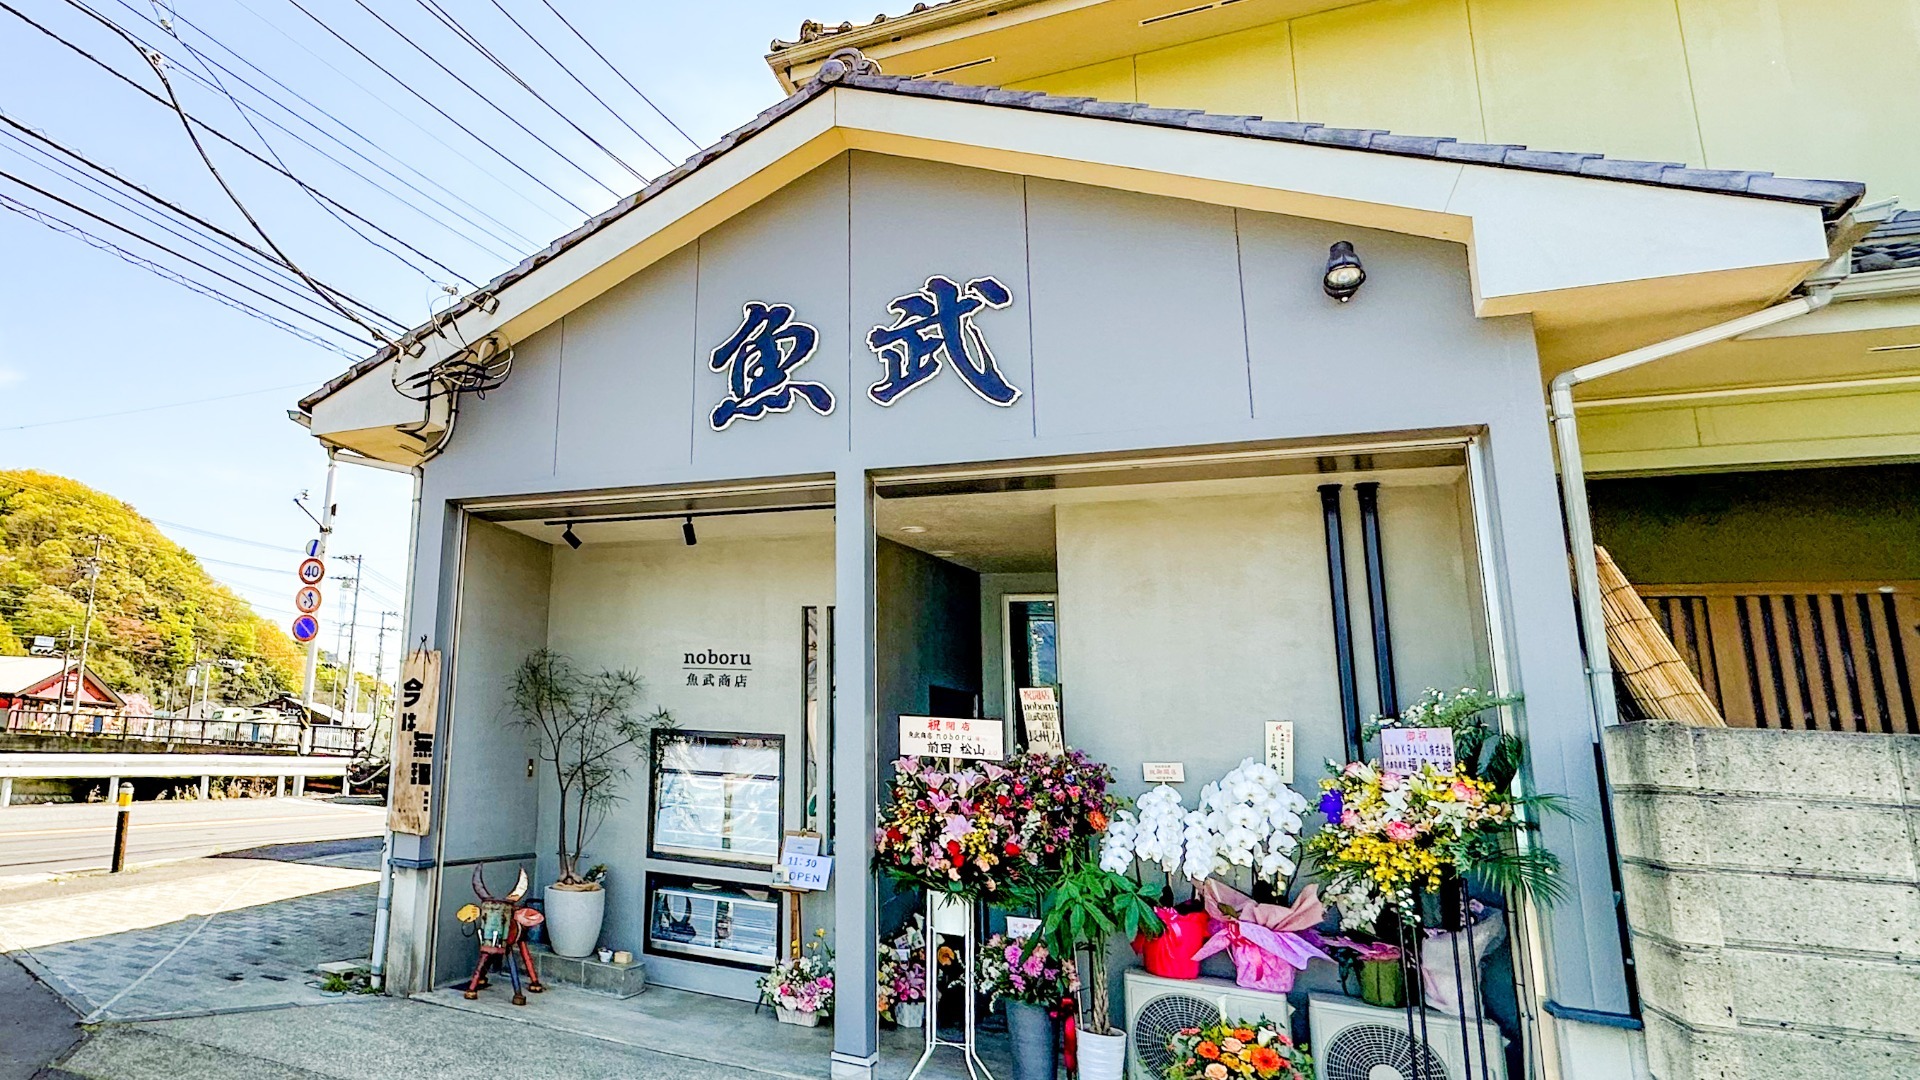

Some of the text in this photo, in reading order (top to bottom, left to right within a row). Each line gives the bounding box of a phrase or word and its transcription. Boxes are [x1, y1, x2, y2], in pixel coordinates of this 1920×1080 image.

[709, 274, 1023, 432] 魚武
[304, 565, 319, 578] 40
[683, 648, 752, 666] noboru
[685, 672, 748, 688] 魚武商店
[1023, 702, 1055, 711] noboru
[936, 733, 972, 741] noboru
[927, 741, 952, 755] 前田
[960, 743, 985, 756] 松山
[788, 856, 818, 868] 11:30
[789, 871, 821, 883] OPEN
